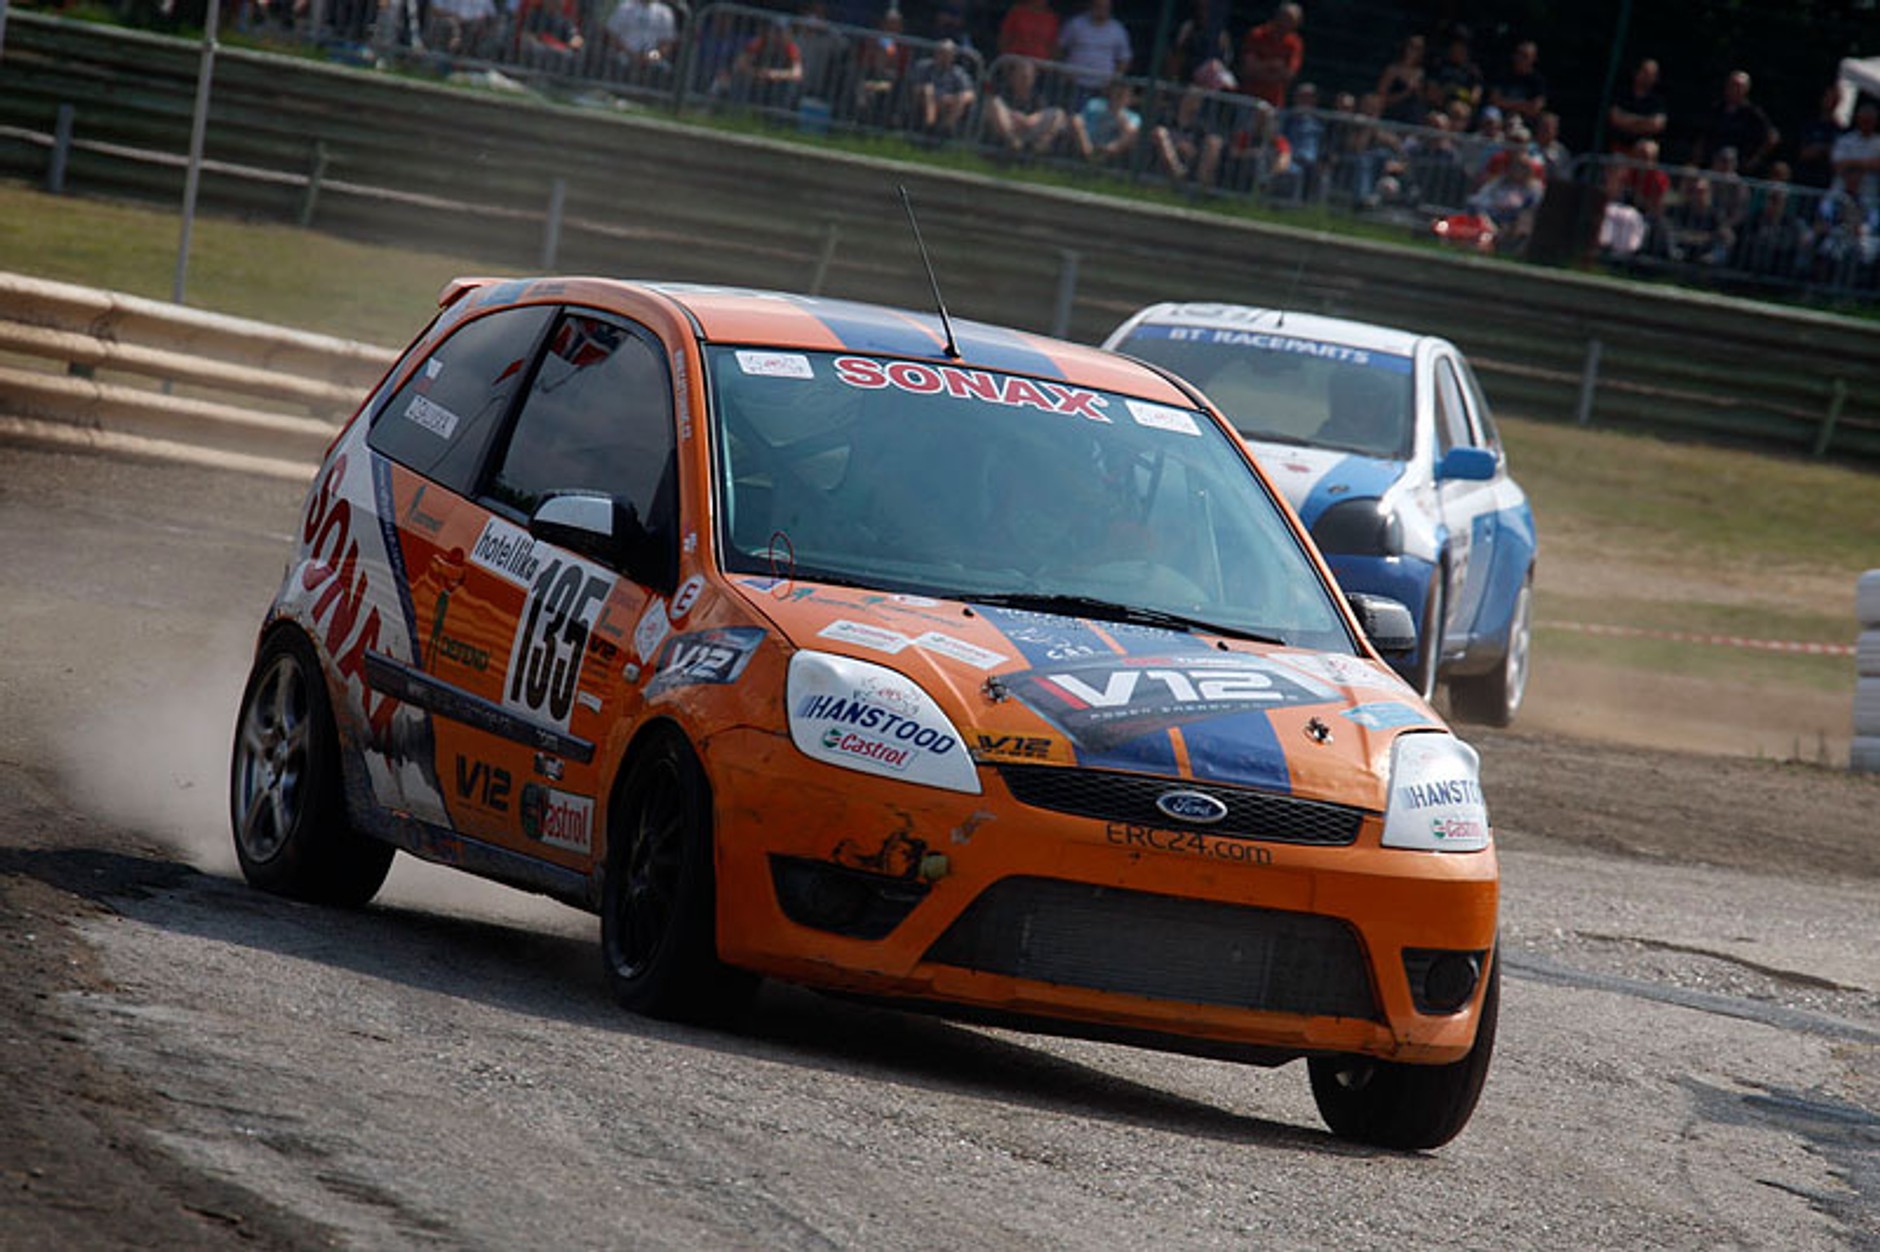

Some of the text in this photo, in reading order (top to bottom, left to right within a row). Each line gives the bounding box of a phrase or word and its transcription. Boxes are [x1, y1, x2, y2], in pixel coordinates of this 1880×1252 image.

[1168, 327, 1370, 365] BT RACEPARTS
[835, 356, 1112, 423] SONAX
[676, 583, 698, 611] E
[510, 558, 611, 721] 135
[660, 642, 735, 679] V12
[1048, 669, 1284, 708] V12
[808, 694, 956, 755] HANSTOOD
[977, 736, 1053, 750] V12
[840, 733, 909, 766] Castrol
[456, 753, 512, 812] V12
[1172, 797, 1213, 816] Ford
[1106, 822, 1272, 865] ERC24.com
